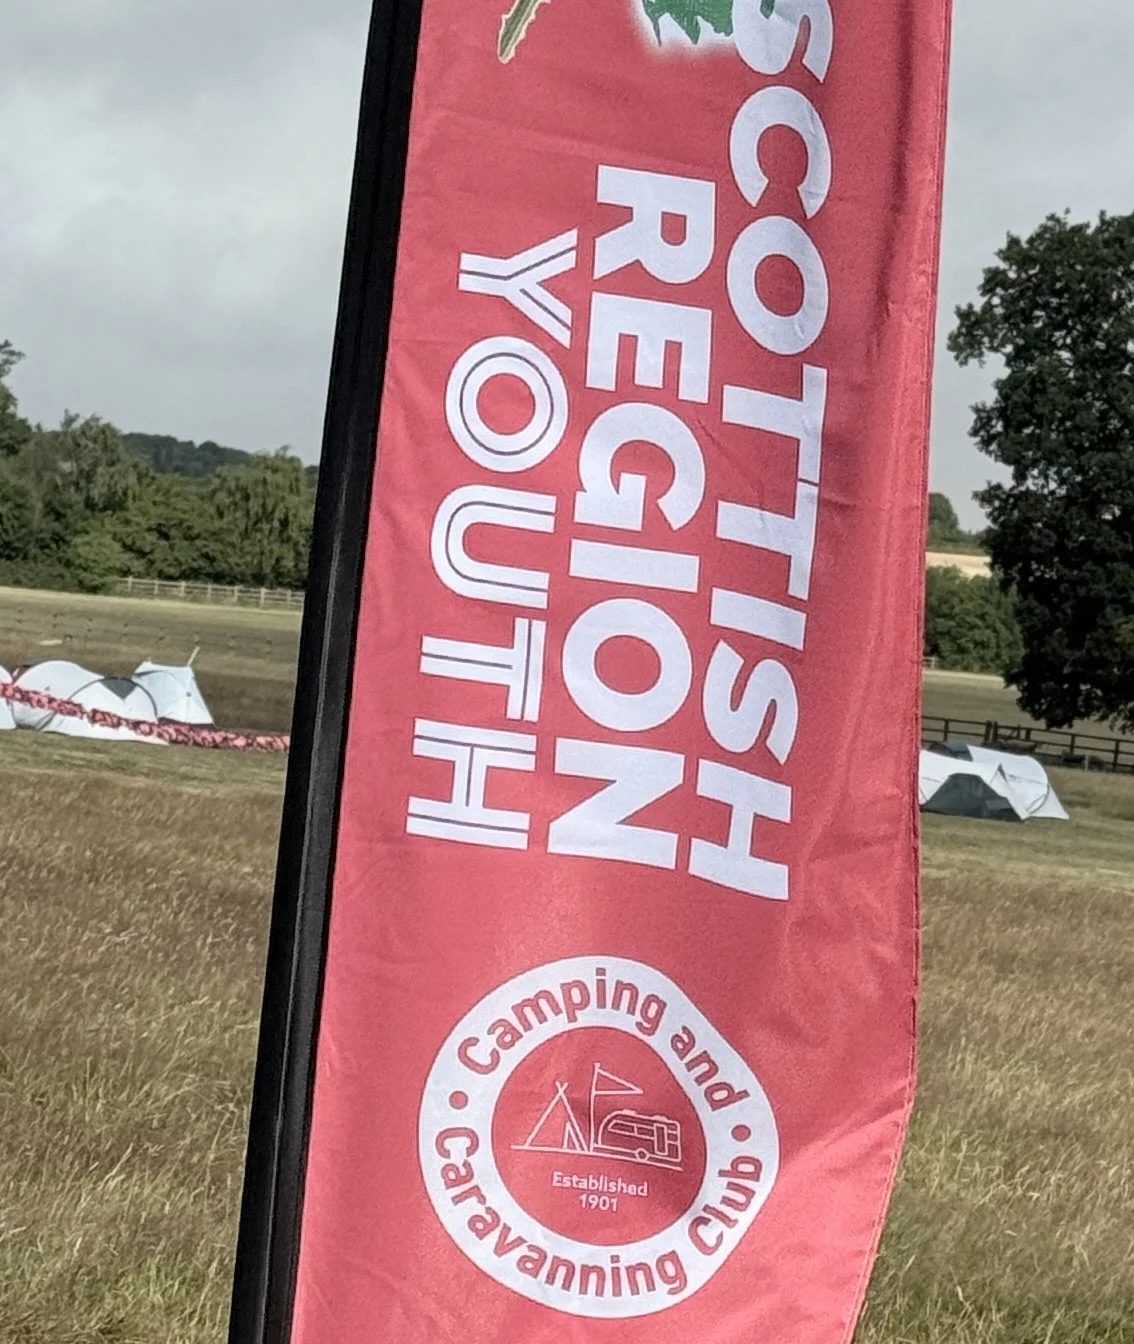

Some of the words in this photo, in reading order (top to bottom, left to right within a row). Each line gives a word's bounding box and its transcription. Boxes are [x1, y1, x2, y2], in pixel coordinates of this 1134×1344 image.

[406, 228, 578, 849] YOUTH
[546, 164, 718, 870] REGION
[457, 967, 667, 1075] Camping
[670, 1025, 750, 1112] and
[435, 1126, 688, 1297] Caravanning
[687, 1155, 763, 1256] Club
[552, 1171, 648, 1196] Established
[579, 1193, 618, 1212] 1901
